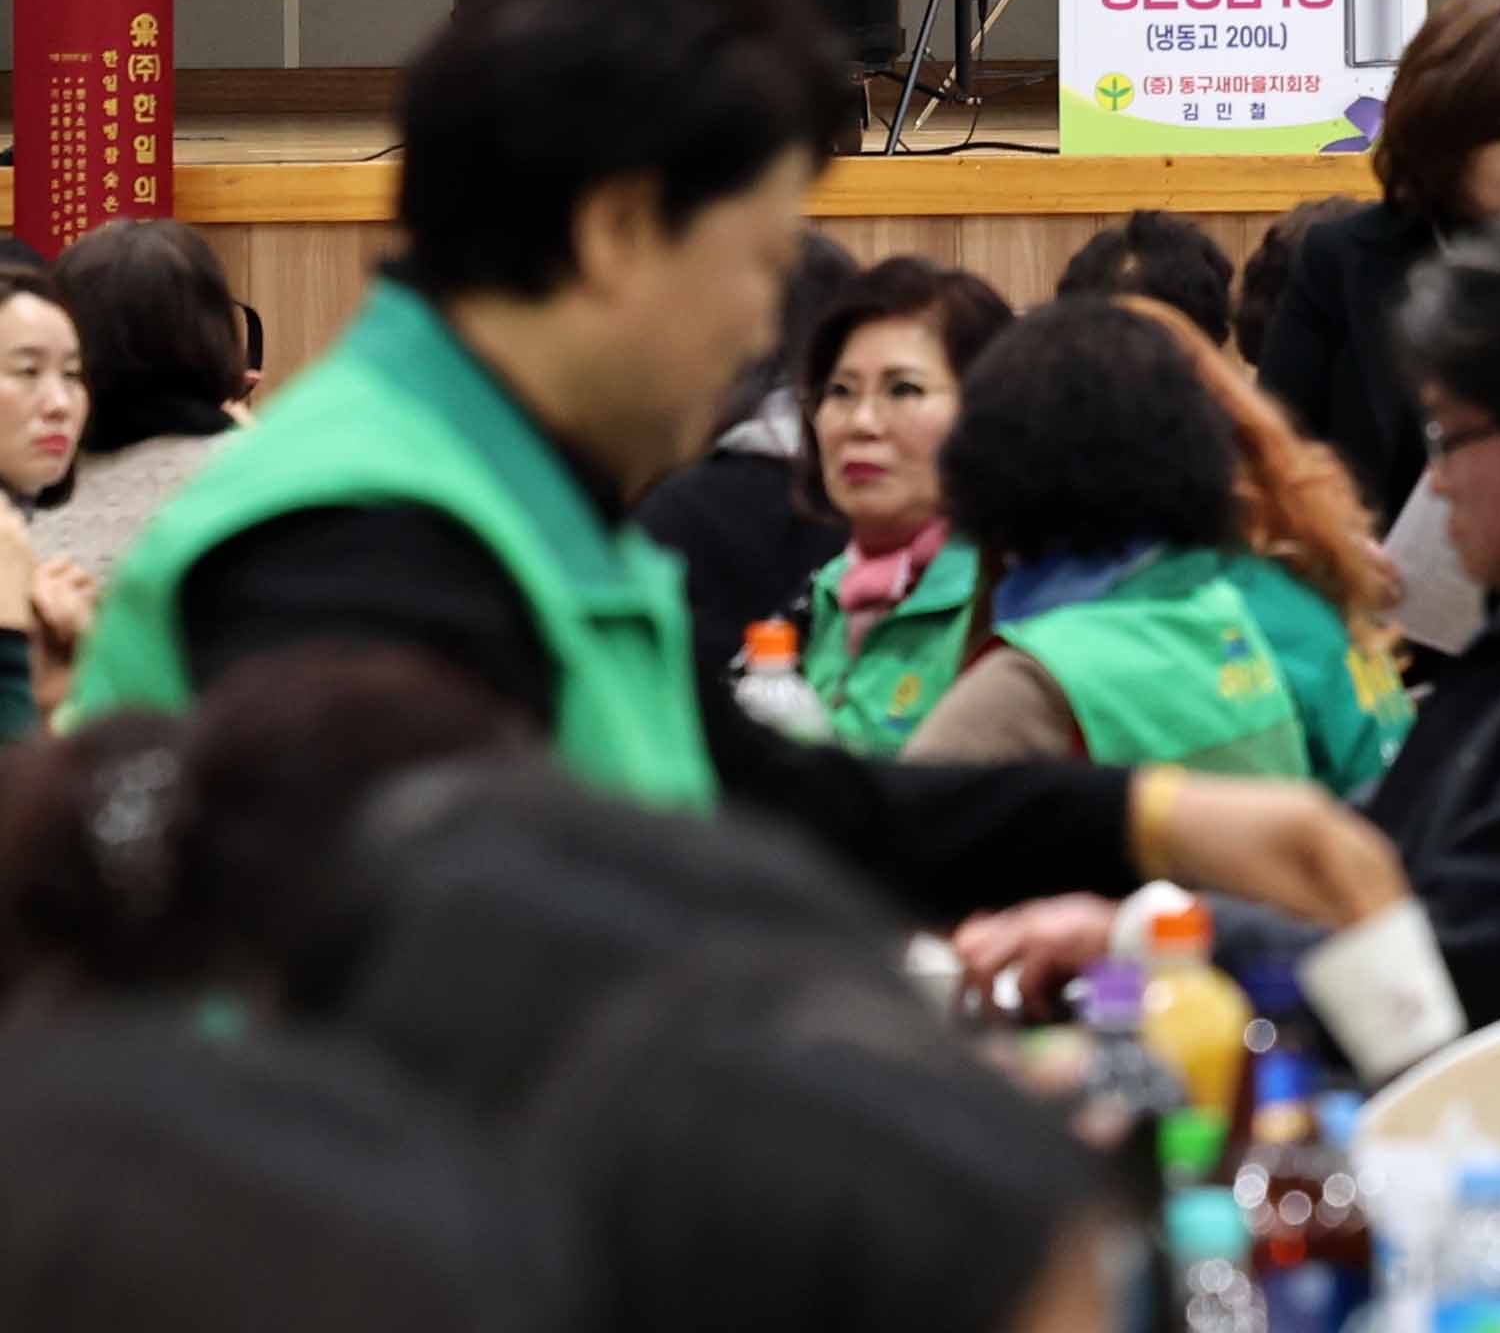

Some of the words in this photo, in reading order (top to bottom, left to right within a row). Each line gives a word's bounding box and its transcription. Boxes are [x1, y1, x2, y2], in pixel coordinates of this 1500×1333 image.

[1146, 23, 1218, 52] (냉동고
[1226, 23, 1289, 51] 200L)
[1143, 76, 1174, 95] (증)
[1179, 75, 1321, 94] 동구새마을지회장
[127, 53, 162, 223] (주)한일의
